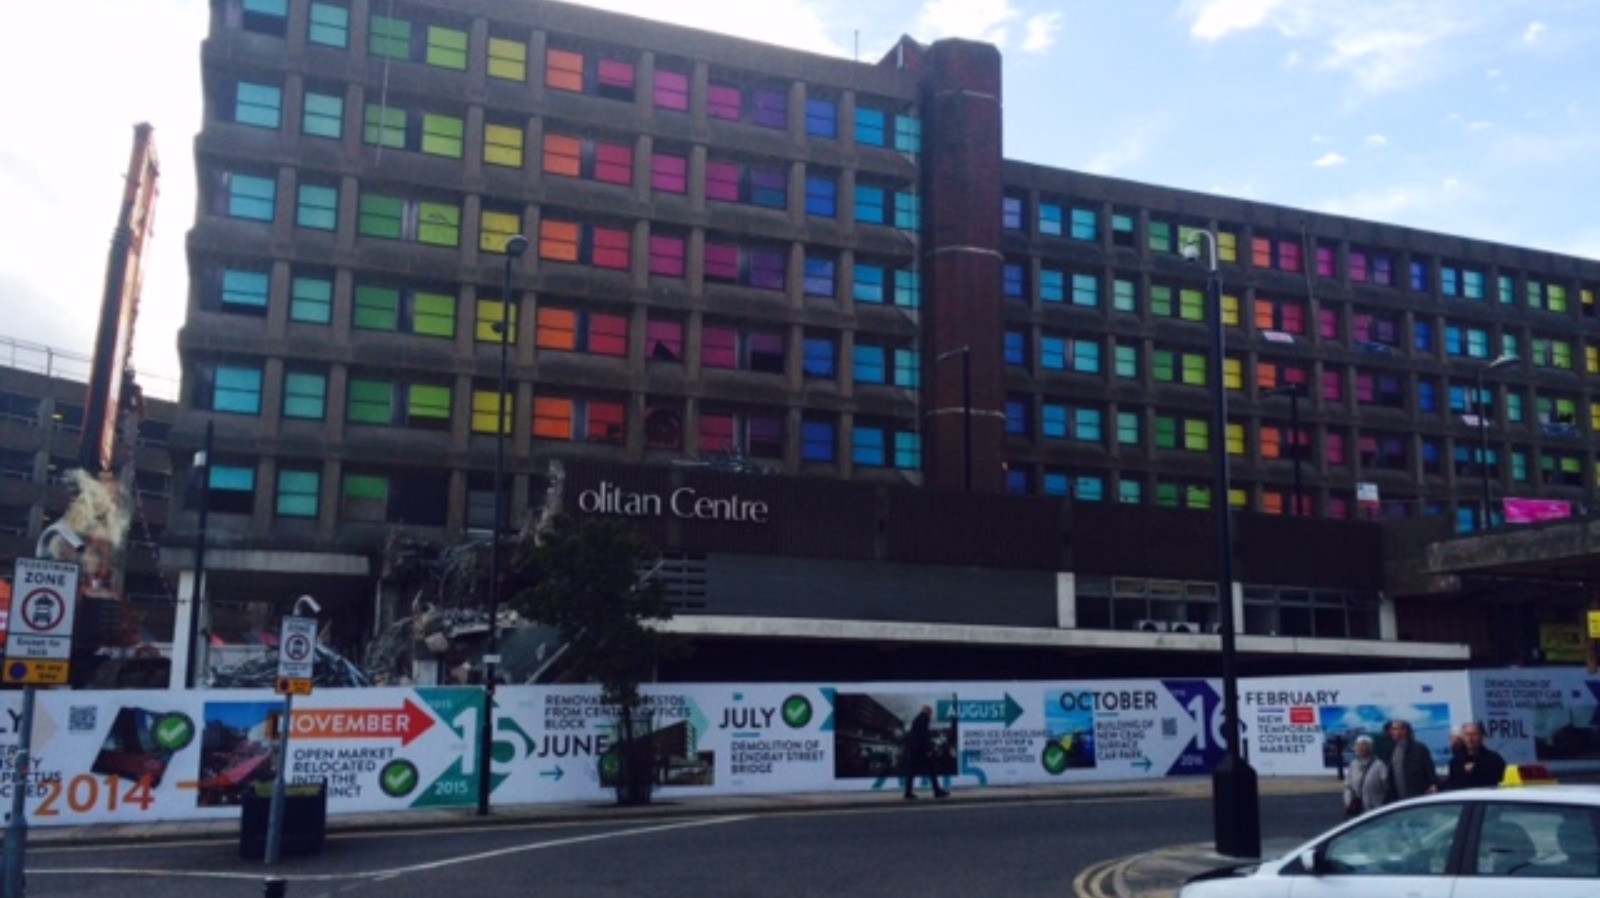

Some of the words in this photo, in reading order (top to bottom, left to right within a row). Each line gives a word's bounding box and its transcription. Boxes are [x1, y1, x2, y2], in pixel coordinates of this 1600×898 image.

[579, 480, 661, 516] olitan
[670, 487, 769, 523] Centre
[24, 572, 66, 586] ZONE
[545, 695, 603, 705] REMOVA
[1059, 690, 1157, 711] OCTOBER
[1245, 689, 1340, 706] FEBRUARY
[544, 707, 581, 718] FROM
[945, 703, 1006, 719] AUGUST
[277, 713, 411, 733] NOVEMBER
[544, 719, 585, 730] BLOCK
[718, 707, 776, 729] JULY
[1257, 714, 1283, 724] NEW
[731, 740, 800, 750] DEMOLITION
[805, 740, 819, 750] OF
[1258, 734, 1315, 743] COVERED
[538, 734, 610, 758] JUNE
[1259, 744, 1306, 753] MARKET
[294, 749, 335, 760] OPEN
[338, 747, 395, 760] MARKET
[731, 751, 784, 762] KENDRAY
[787, 750, 825, 762] STREET
[293, 760, 376, 773] RELOCATED
[731, 763, 773, 774] BRIDGE
[331, 773, 357, 784] THE
[34, 774, 156, 817] 2014
[434, 782, 468, 796] 2015
